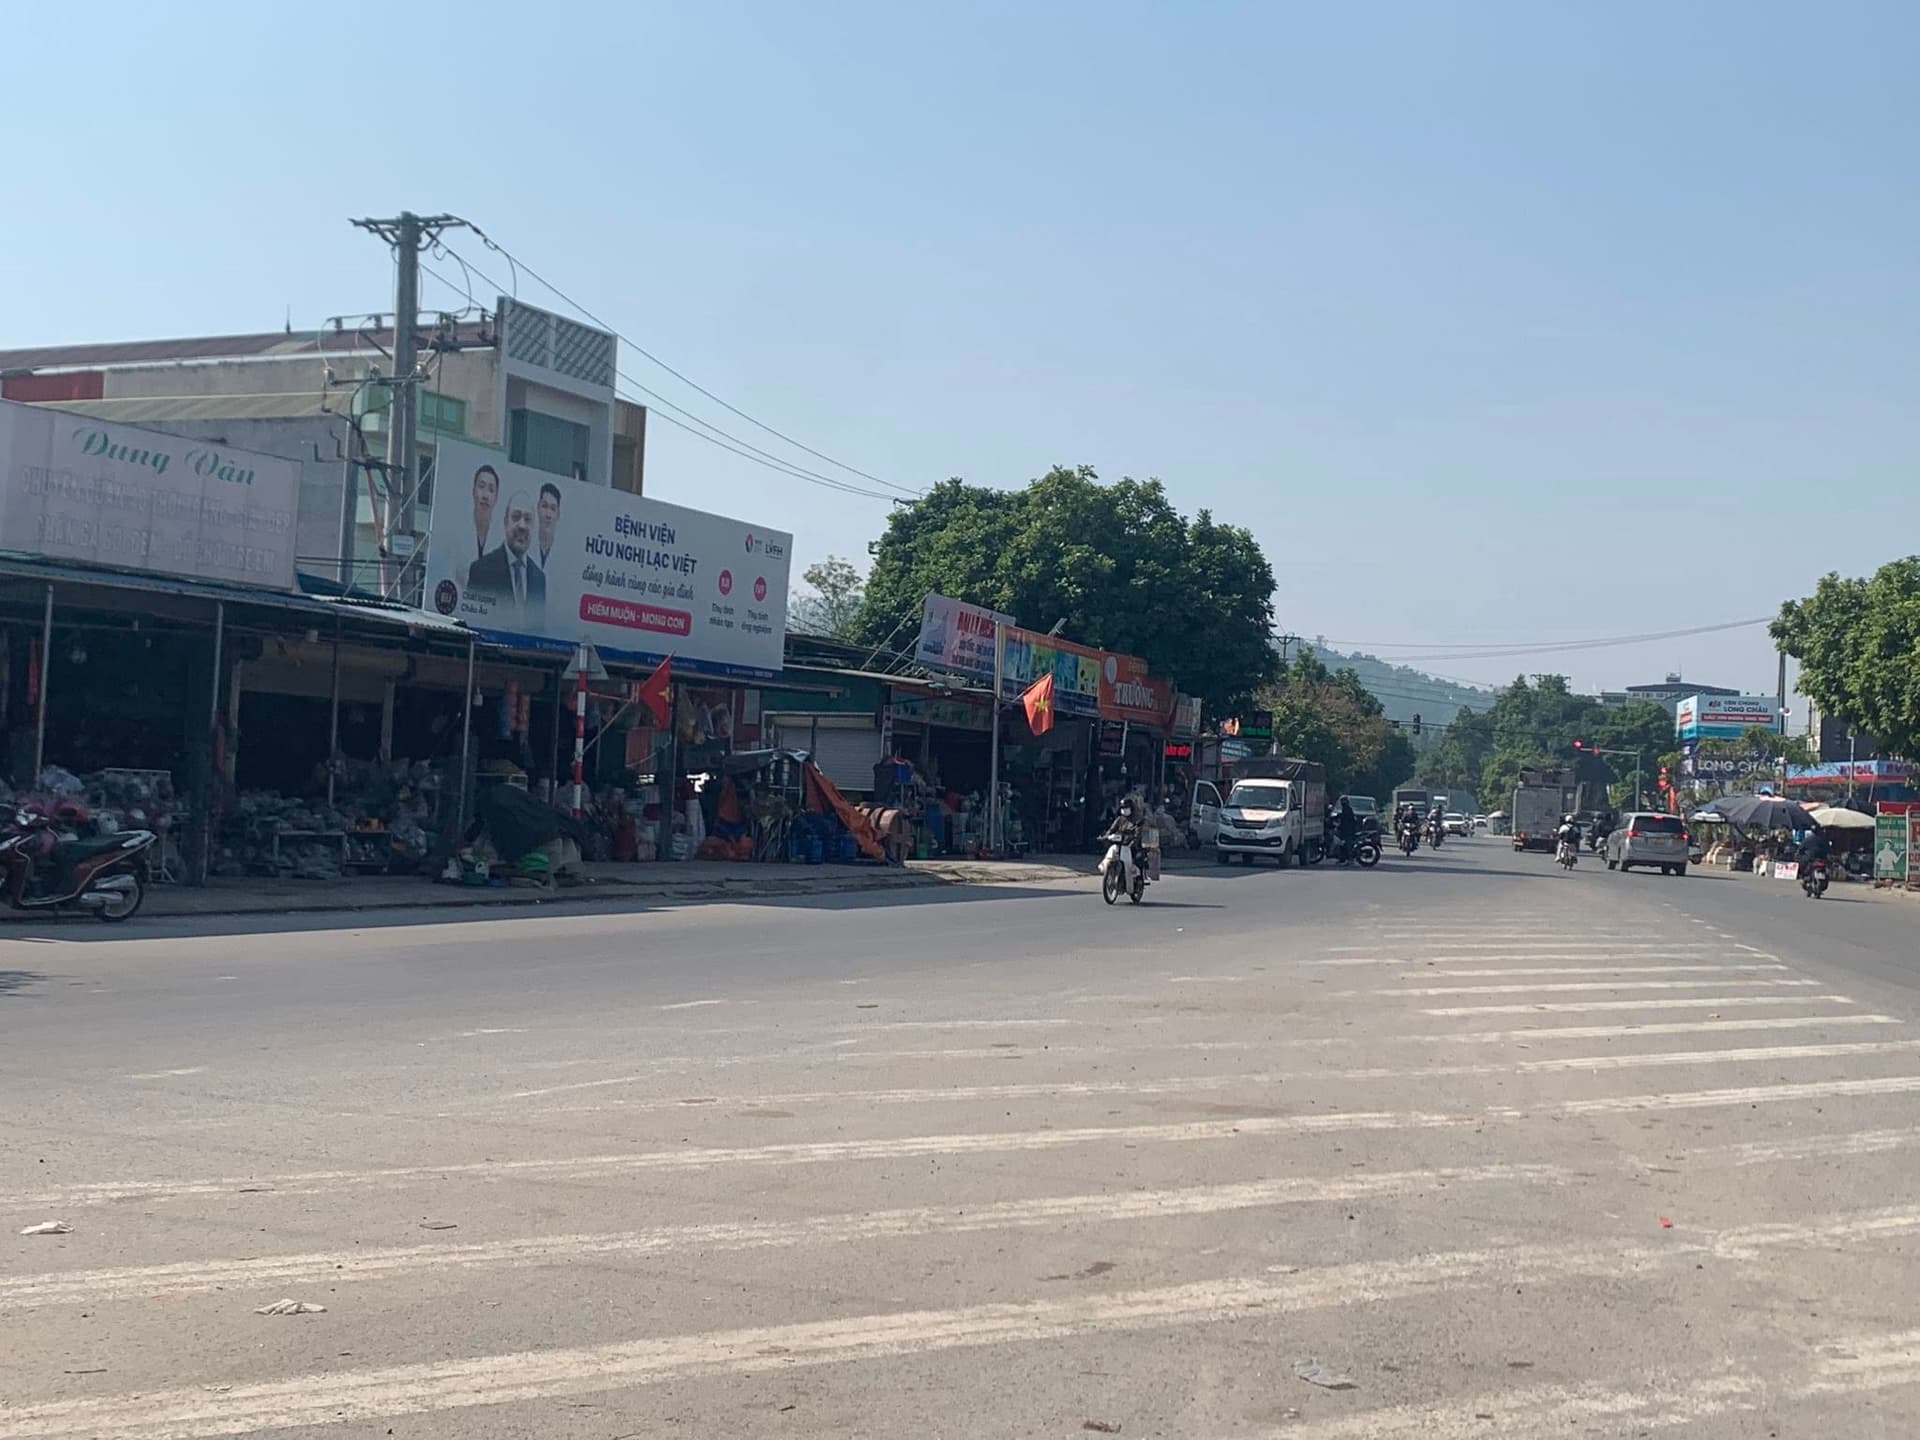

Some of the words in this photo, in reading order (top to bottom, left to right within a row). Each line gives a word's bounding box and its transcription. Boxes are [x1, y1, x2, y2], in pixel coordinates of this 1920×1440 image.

[615, 514, 646, 539] BỆNH
[649, 523, 676, 547] VIỆN
[586, 534, 614, 557] HỮU
[616, 542, 645, 569] NGHỊ
[646, 549, 670, 571] LẠC
[672, 553, 698, 577] VIỆT
[582, 564, 603, 587] đồng
[605, 568, 626, 588] hành
[627, 574, 647, 595] cùng
[648, 578, 661, 593] các
[662, 581, 675, 600] gia
[677, 583, 694, 600] đình
[587, 600, 609, 616] HIẾM
[610, 605, 636, 625] MUỘN
[641, 611, 666, 627] MONG
[667, 616, 685, 630] CON
[1698, 759, 1735, 771] LONG
